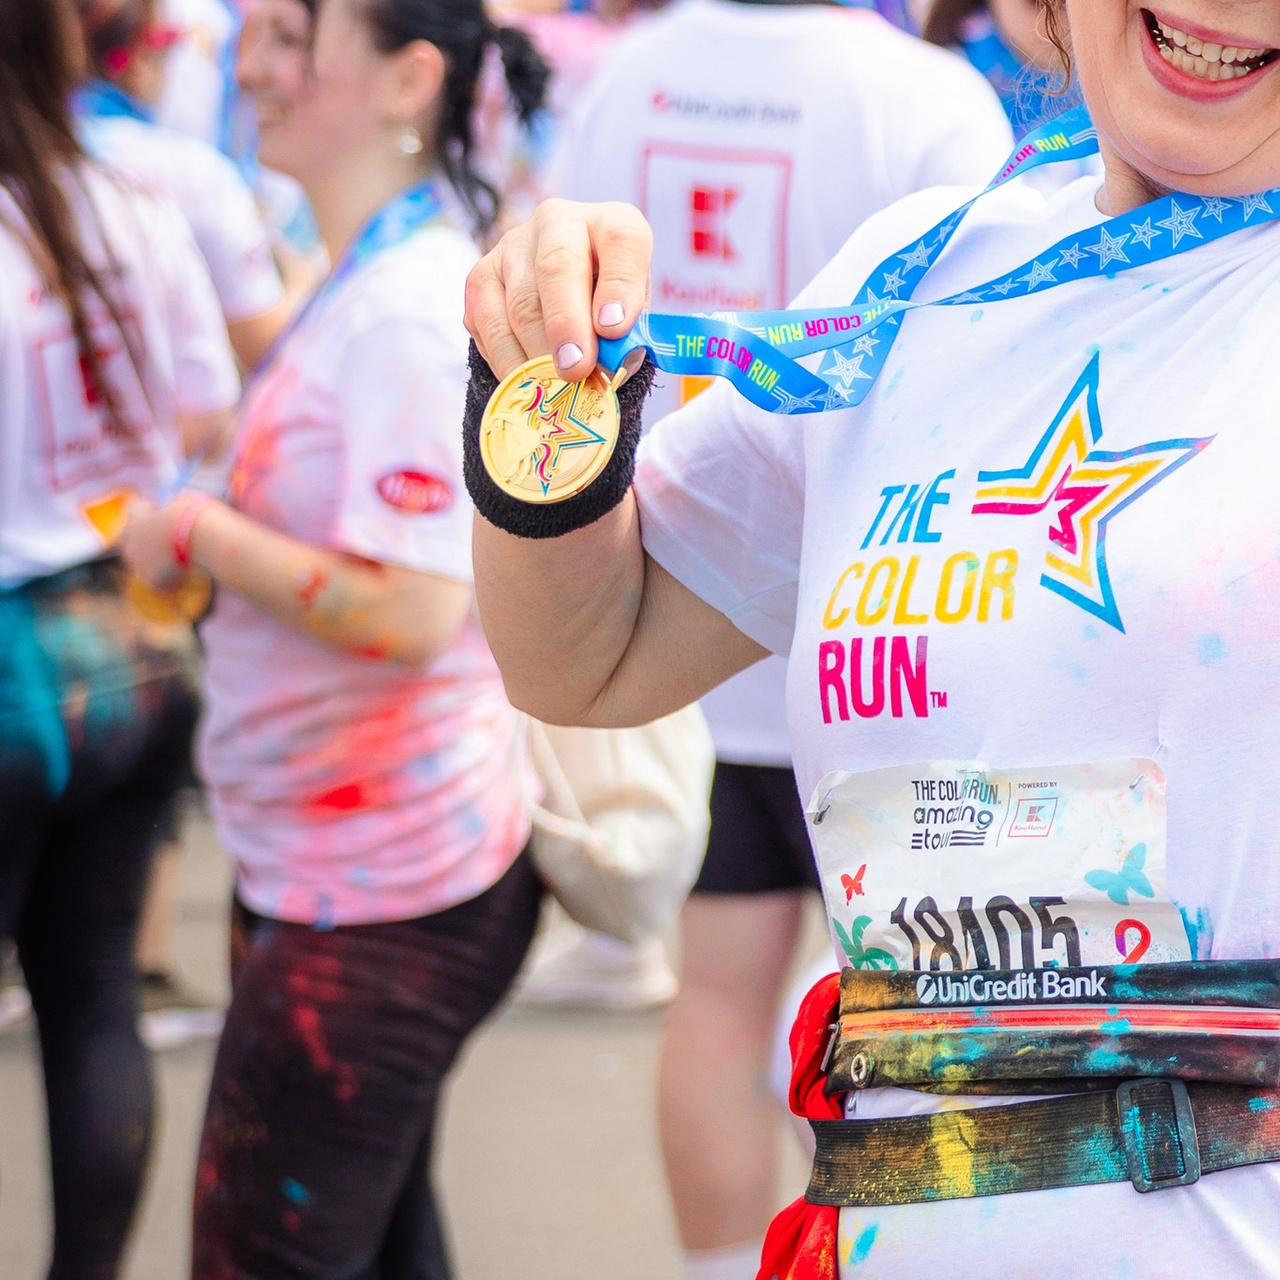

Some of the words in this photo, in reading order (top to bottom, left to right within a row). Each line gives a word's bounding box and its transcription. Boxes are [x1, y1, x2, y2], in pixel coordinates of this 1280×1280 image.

[1035, 132, 1070, 152] RUN
[768, 322, 804, 346] RUN
[805, 314, 862, 337] COLOR
[675, 334, 706, 358] THE
[706, 336, 753, 375] COLOR
[747, 358, 781, 393] RUN
[859, 468, 957, 550] THE
[822, 548, 1020, 630] COLOR
[911, 780, 936, 801] THE
[913, 801, 994, 831] amazing
[890, 895, 1083, 971] 18405
[938, 972, 1037, 1003] UniCredit
[1042, 969, 1108, 998] Bank
